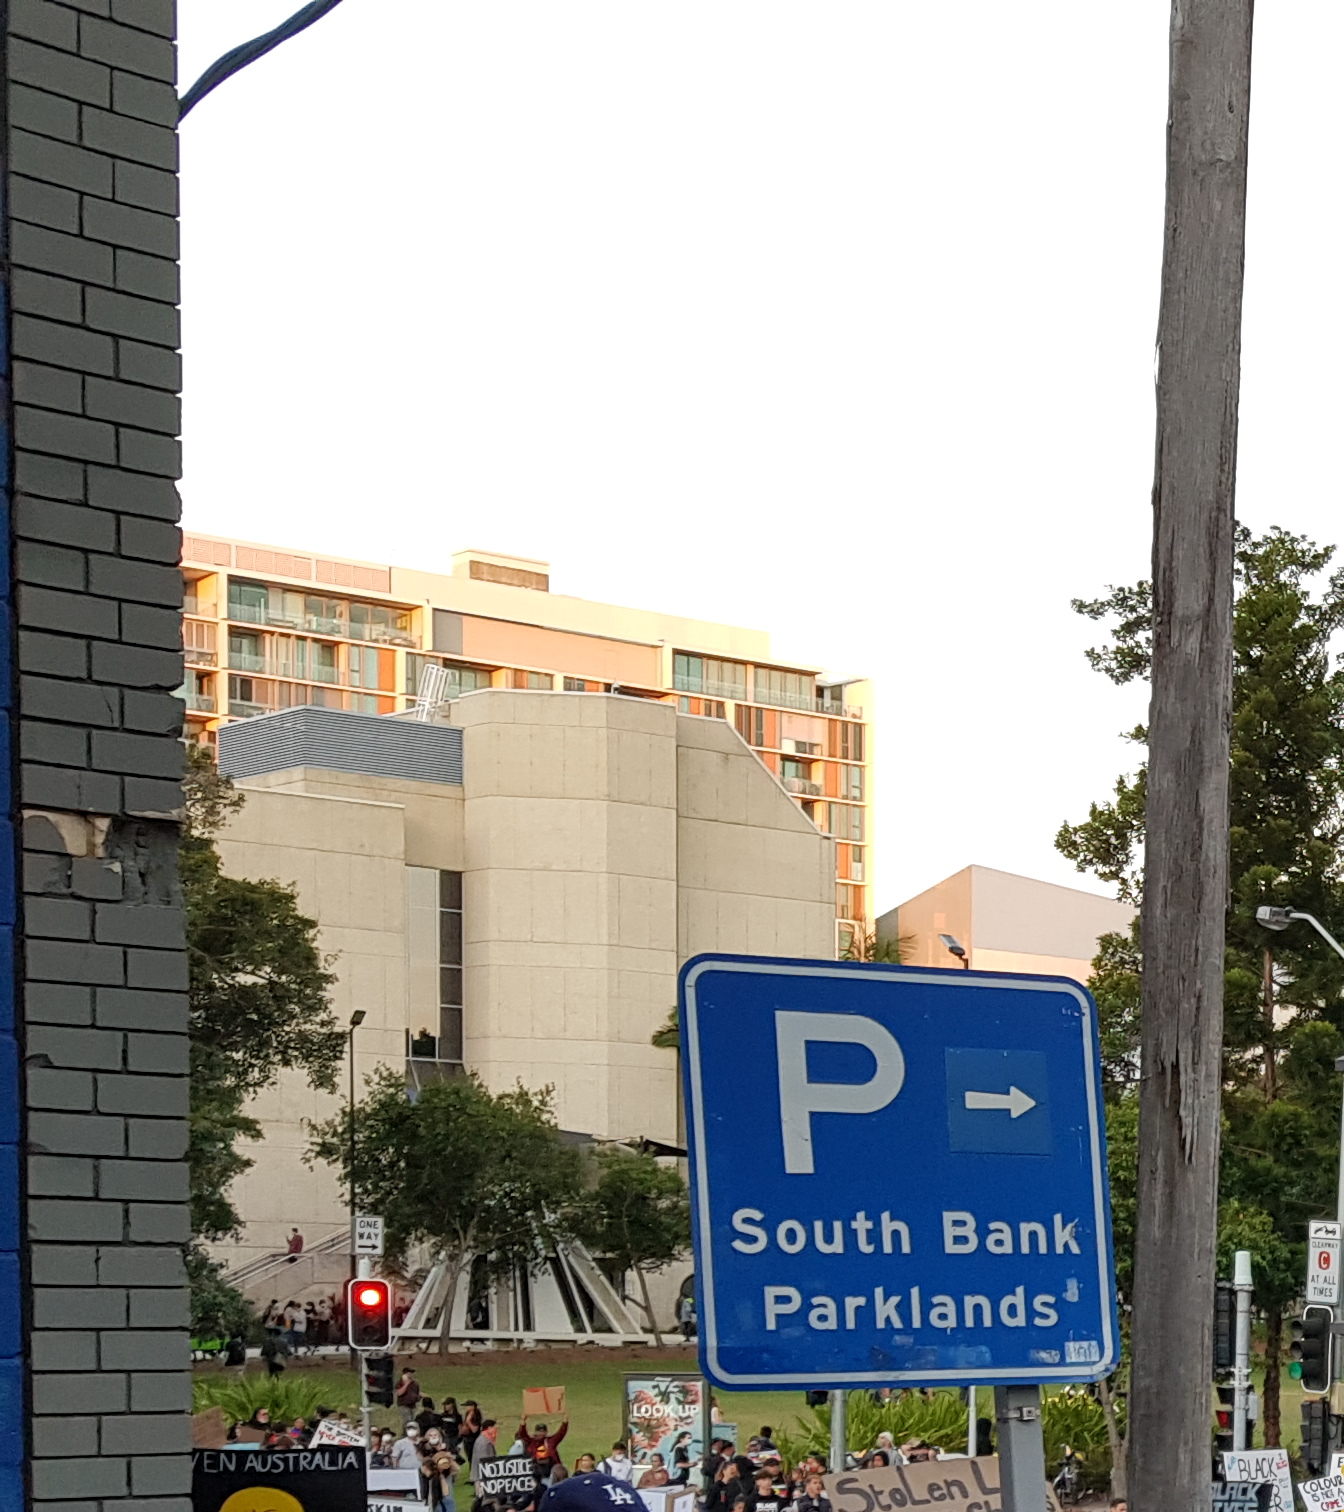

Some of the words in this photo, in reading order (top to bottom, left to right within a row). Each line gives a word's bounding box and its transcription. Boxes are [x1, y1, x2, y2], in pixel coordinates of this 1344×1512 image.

[775, 1010, 906, 1174] P
[359, 1220, 379, 1229] ONE
[731, 1207, 911, 1255] South
[942, 1210, 1082, 1255] Bank
[358, 1231, 380, 1240] WAY
[1311, 1241, 1339, 1249] CLEARWAY
[1310, 1274, 1320, 1284] AT
[1322, 1275, 1336, 1285] ALL
[1313, 1286, 1333, 1298] TIMES
[763, 1285, 1059, 1332] Parklands
[633, 1404, 673, 1418] LOOK
[678, 1404, 699, 1417] UP
[243, 1449, 360, 1473] AUSTRALIA
[479, 1462, 497, 1479] NO
[496, 1458, 534, 1477] JUSTICE
[1238, 1457, 1277, 1481] BLACK
[481, 1480, 498, 1495] NO
[497, 1475, 535, 1494] PEACE
[602, 1484, 636, 1506] LA
[1303, 1474, 1344, 1495] COLOUR
